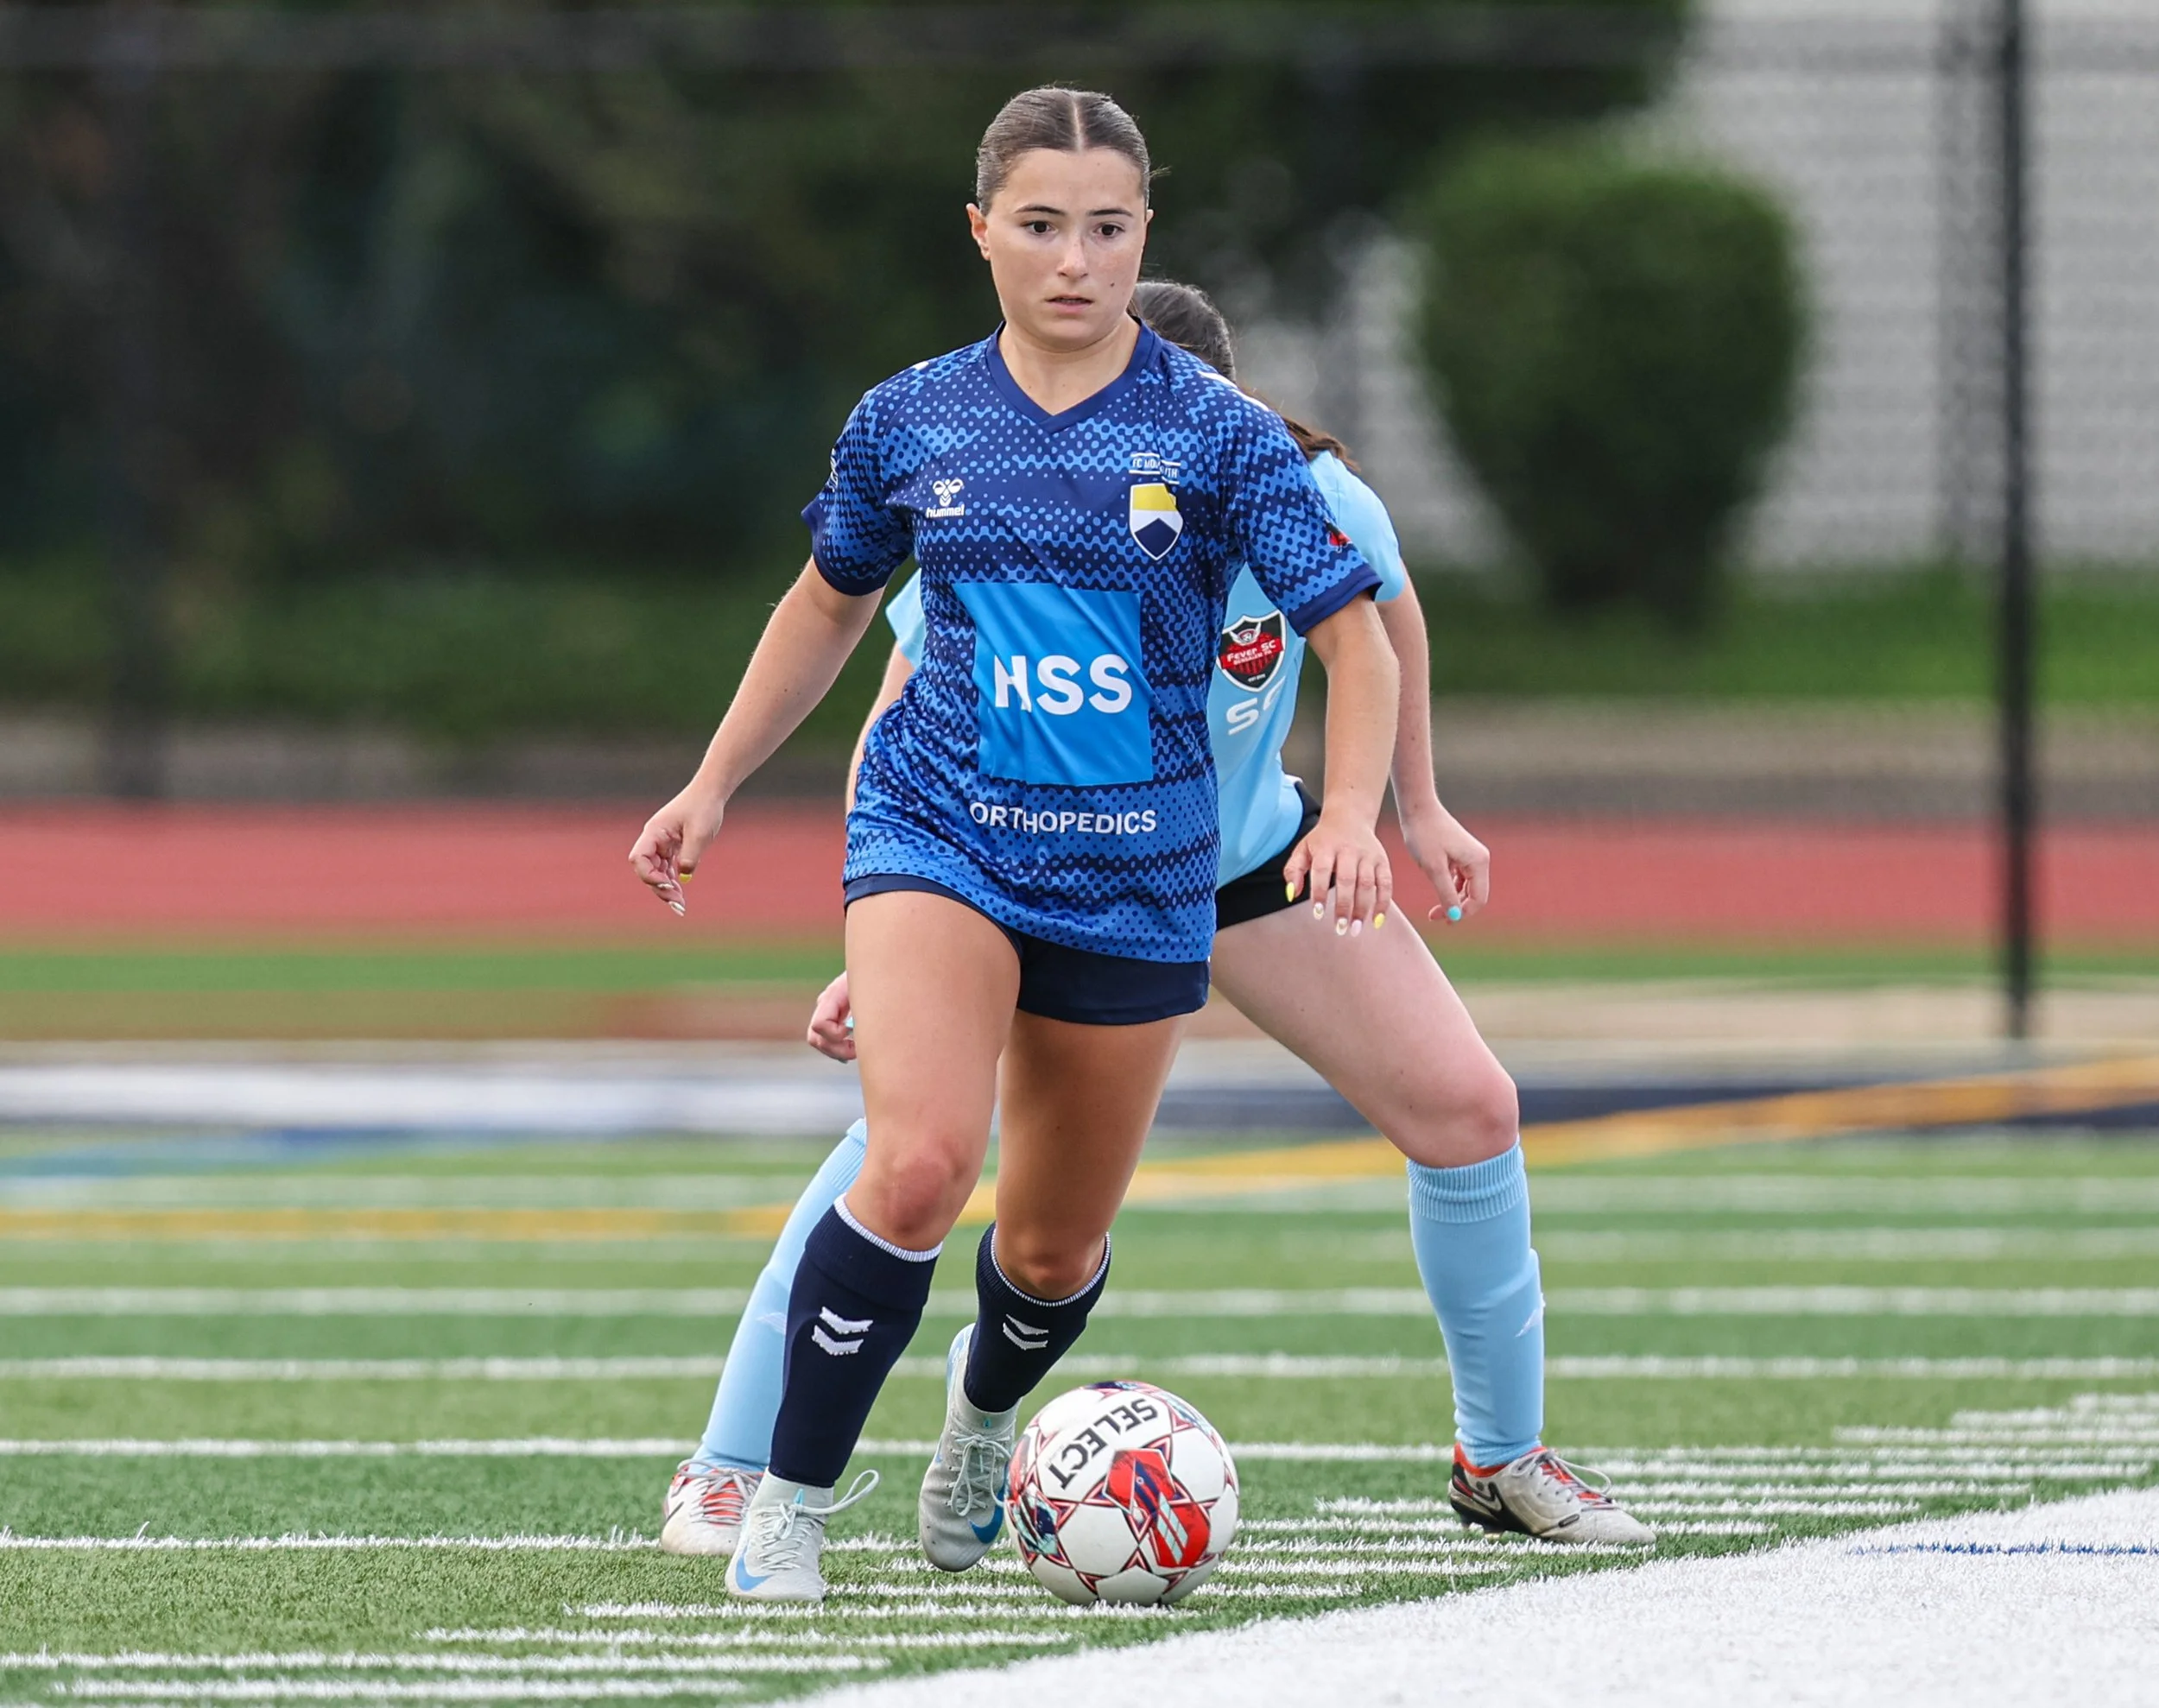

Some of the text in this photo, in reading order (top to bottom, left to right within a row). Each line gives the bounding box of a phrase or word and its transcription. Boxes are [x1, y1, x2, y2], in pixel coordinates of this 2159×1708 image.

[1132, 458, 1143, 468] FC
[925, 503, 965, 518] hummel
[1261, 639, 1276, 650] SC
[994, 654, 1132, 716] HSS
[969, 801, 1157, 835] ORTHOPEDICS
[1048, 1398, 1158, 1490] SELECT
